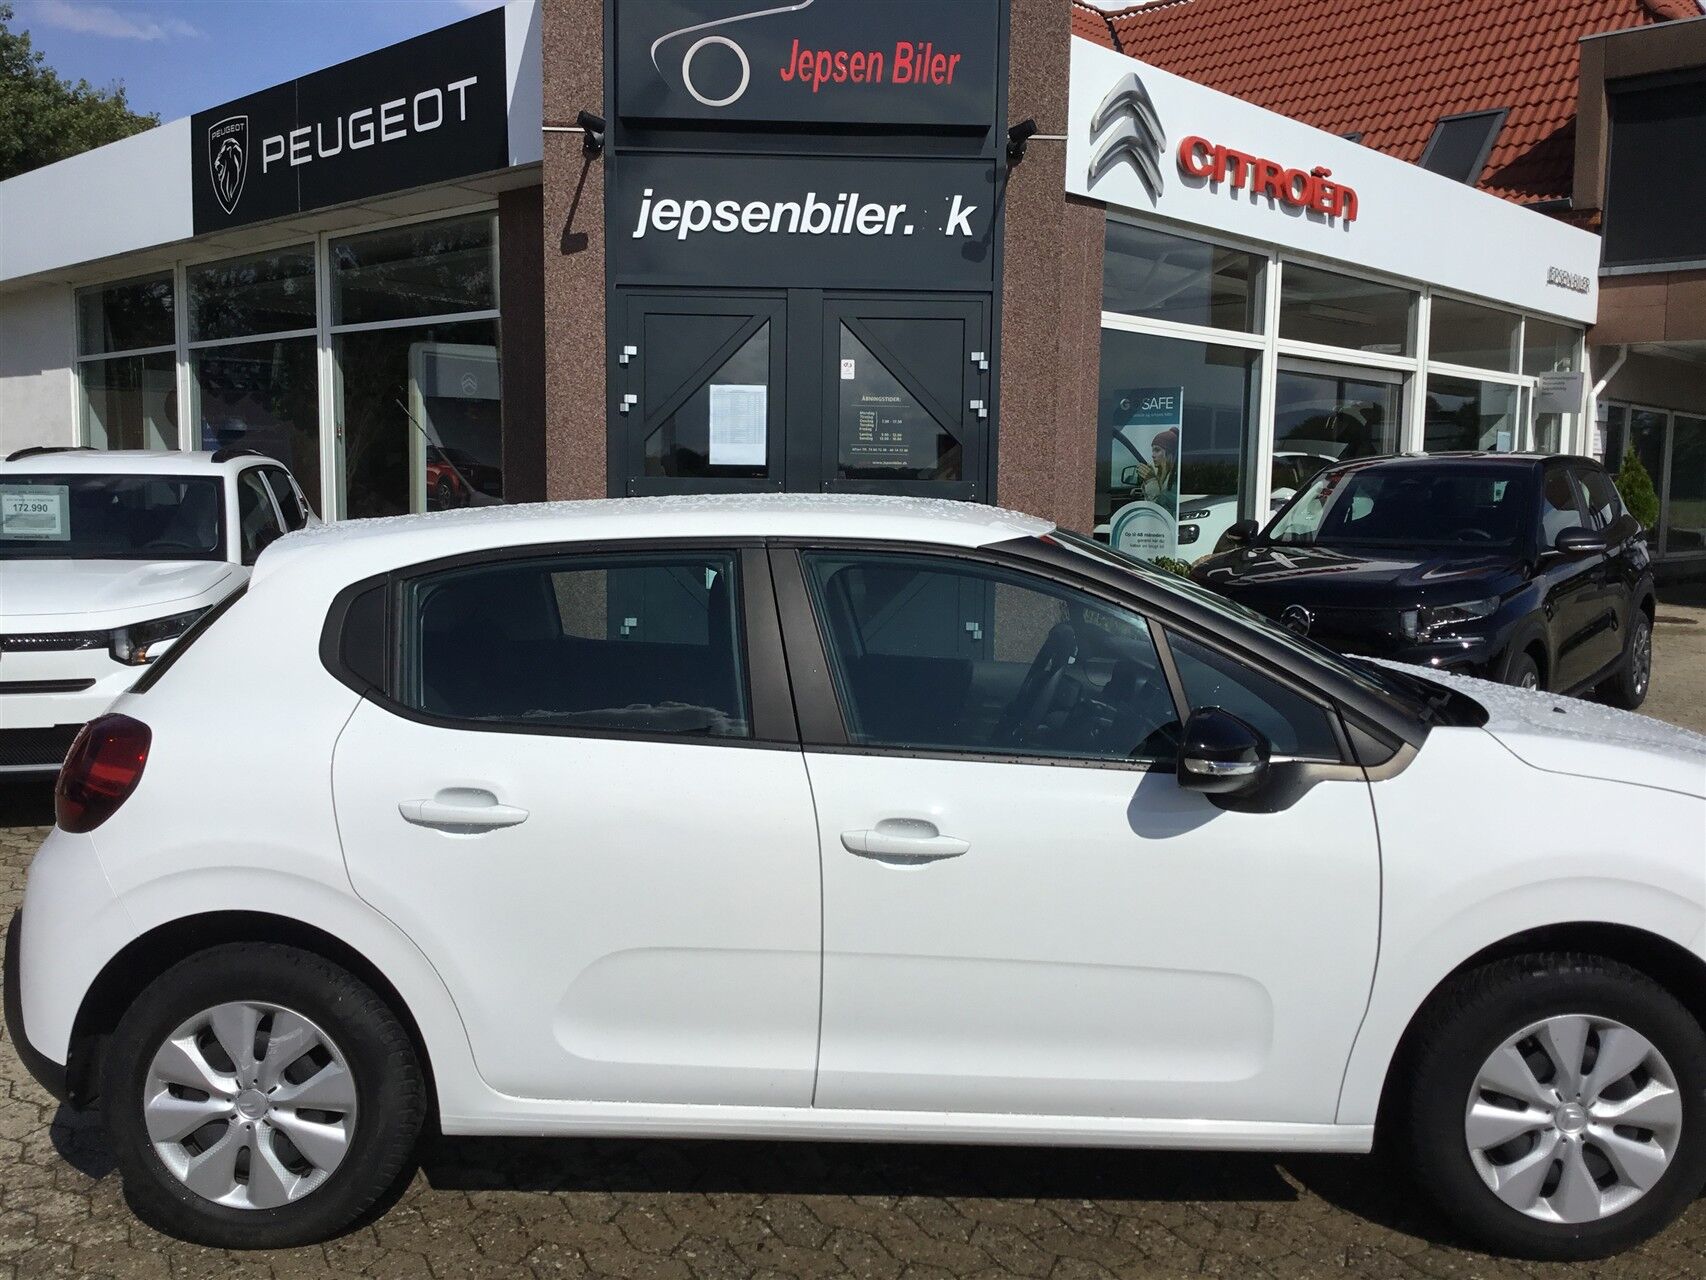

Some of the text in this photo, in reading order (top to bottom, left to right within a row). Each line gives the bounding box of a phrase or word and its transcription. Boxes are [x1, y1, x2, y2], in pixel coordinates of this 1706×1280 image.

[780, 38, 960, 93] Jepsen Biler
[211, 122, 245, 141] PEUGEOT
[263, 76, 477, 174] PEUGEOT
[1142, 396, 1174, 410] SAFE
[13, 503, 48, 512] 172.990
